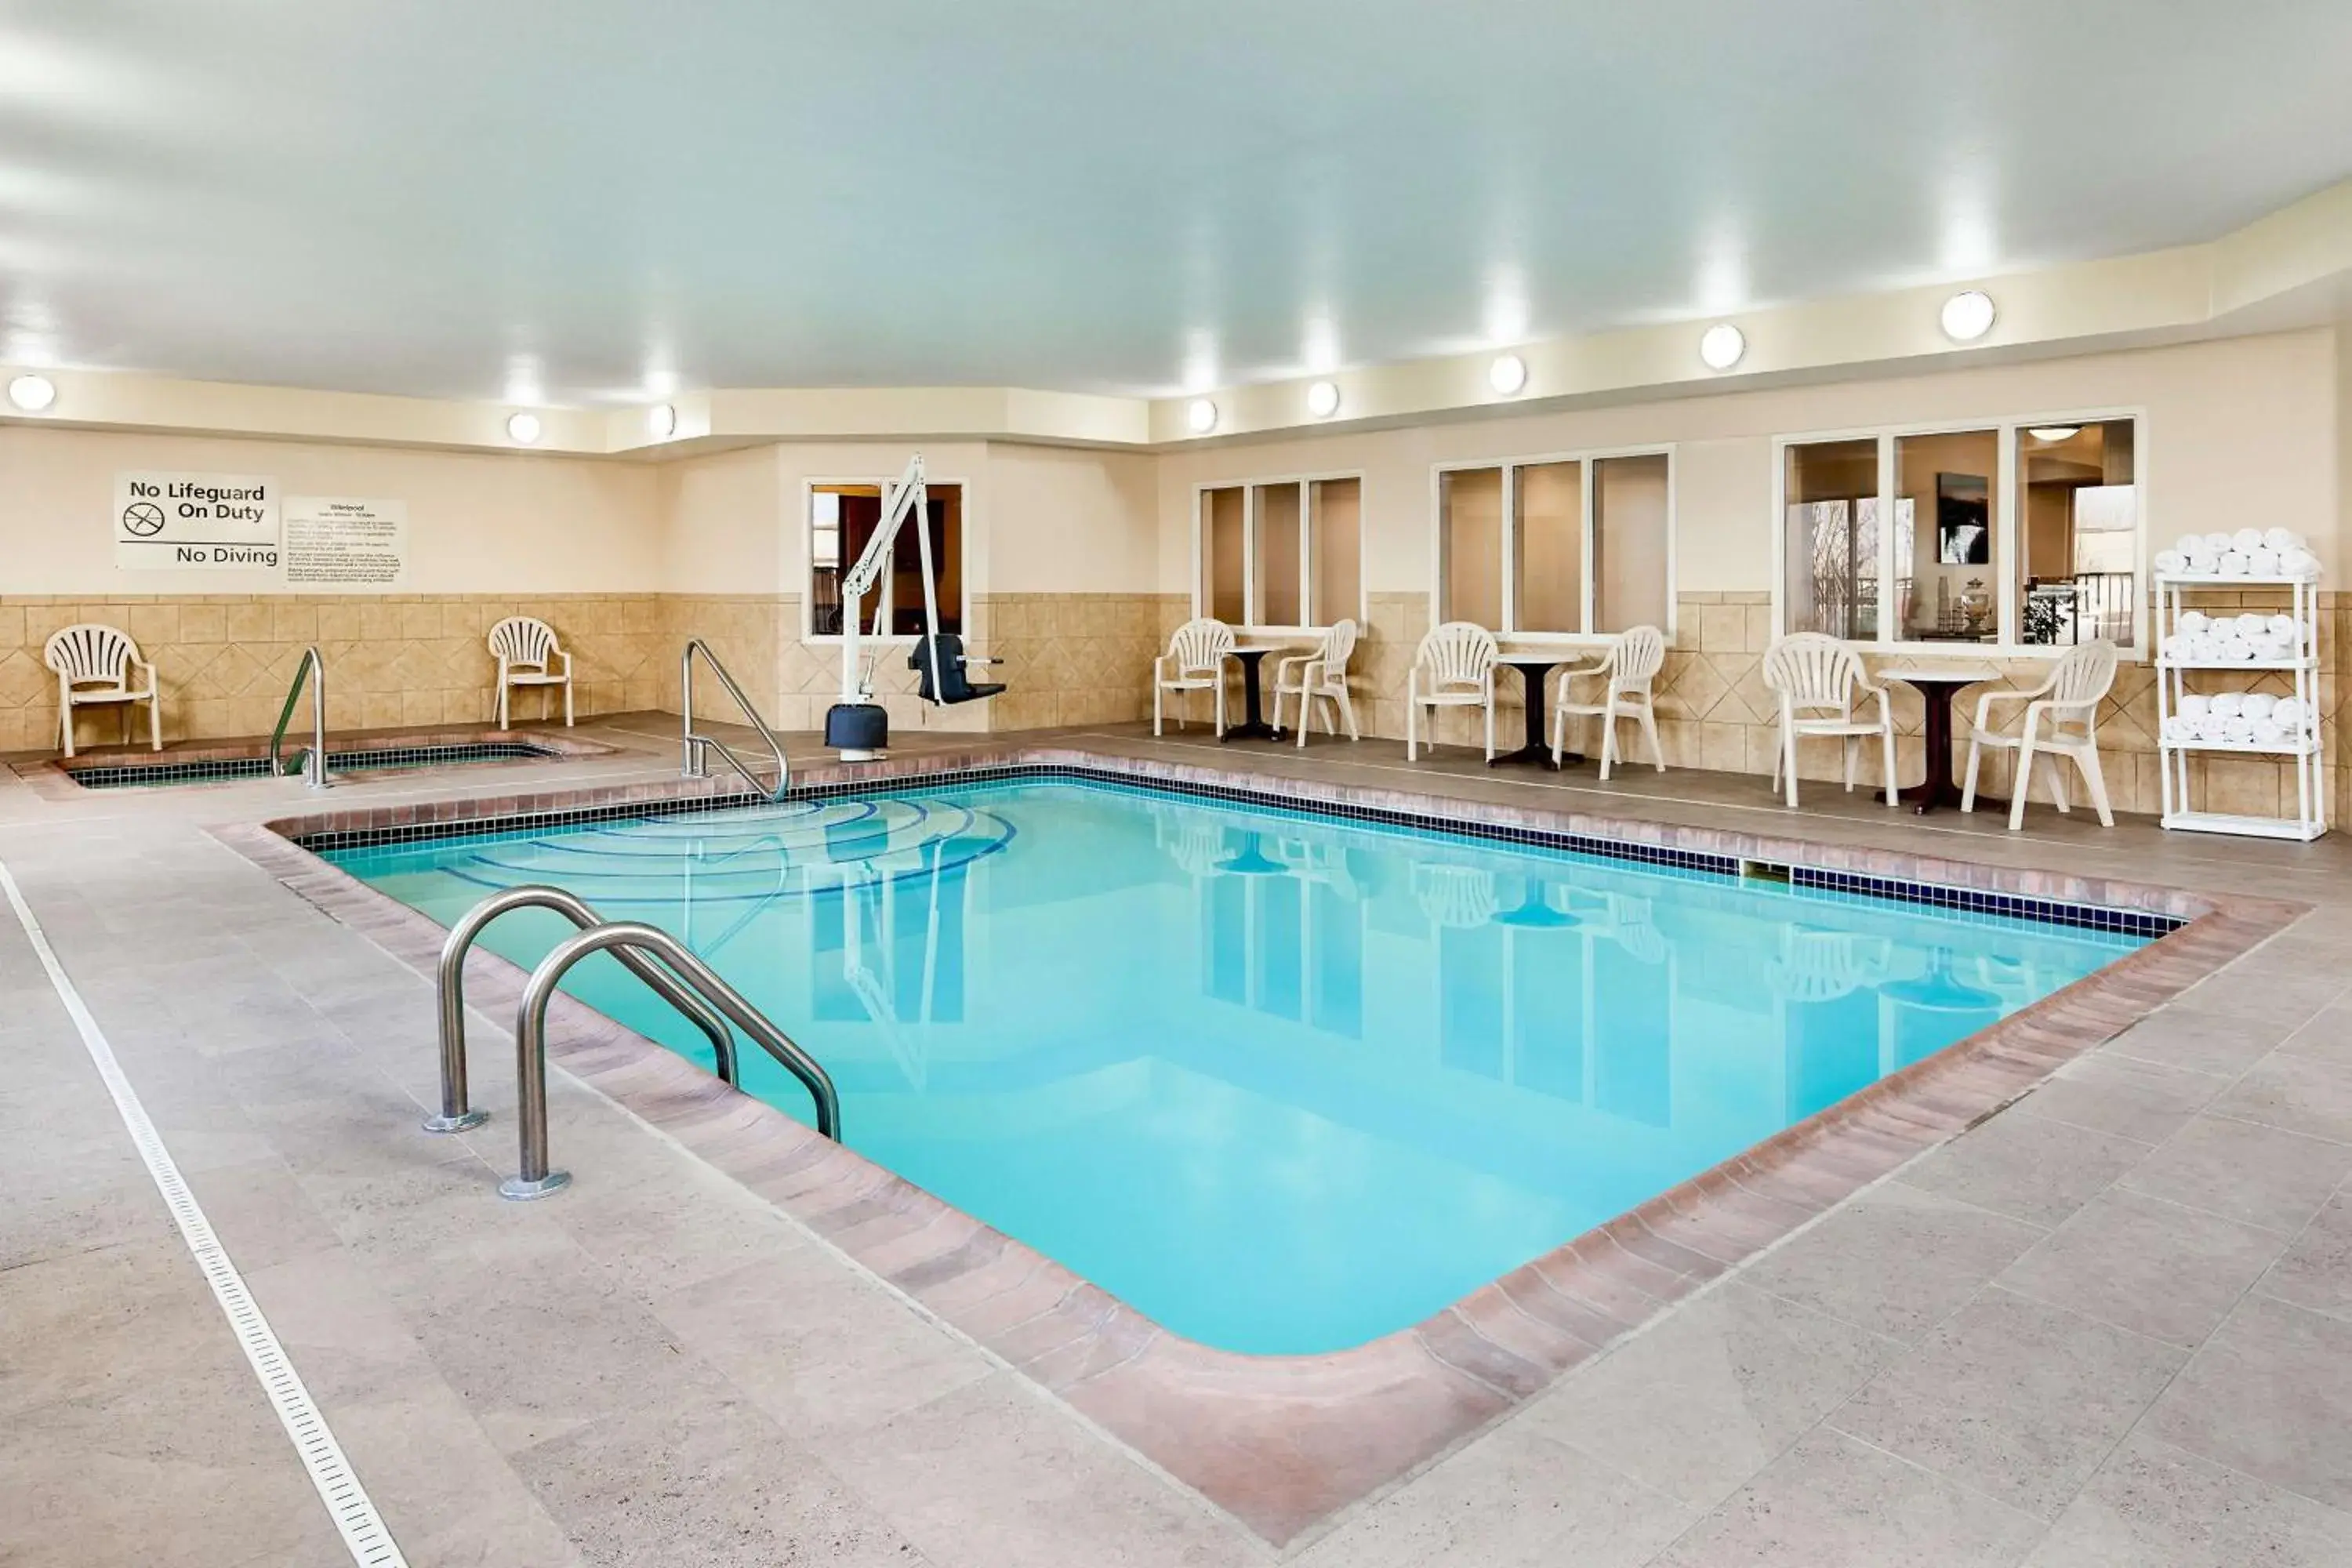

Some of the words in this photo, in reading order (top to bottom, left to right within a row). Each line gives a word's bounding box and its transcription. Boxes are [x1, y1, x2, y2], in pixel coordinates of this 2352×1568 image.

[131, 482, 161, 498] No
[169, 483, 265, 503] Lifeguard
[178, 503, 208, 518] On
[216, 504, 264, 523] Duty
[177, 547, 206, 562] No
[214, 547, 278, 567] Diving
